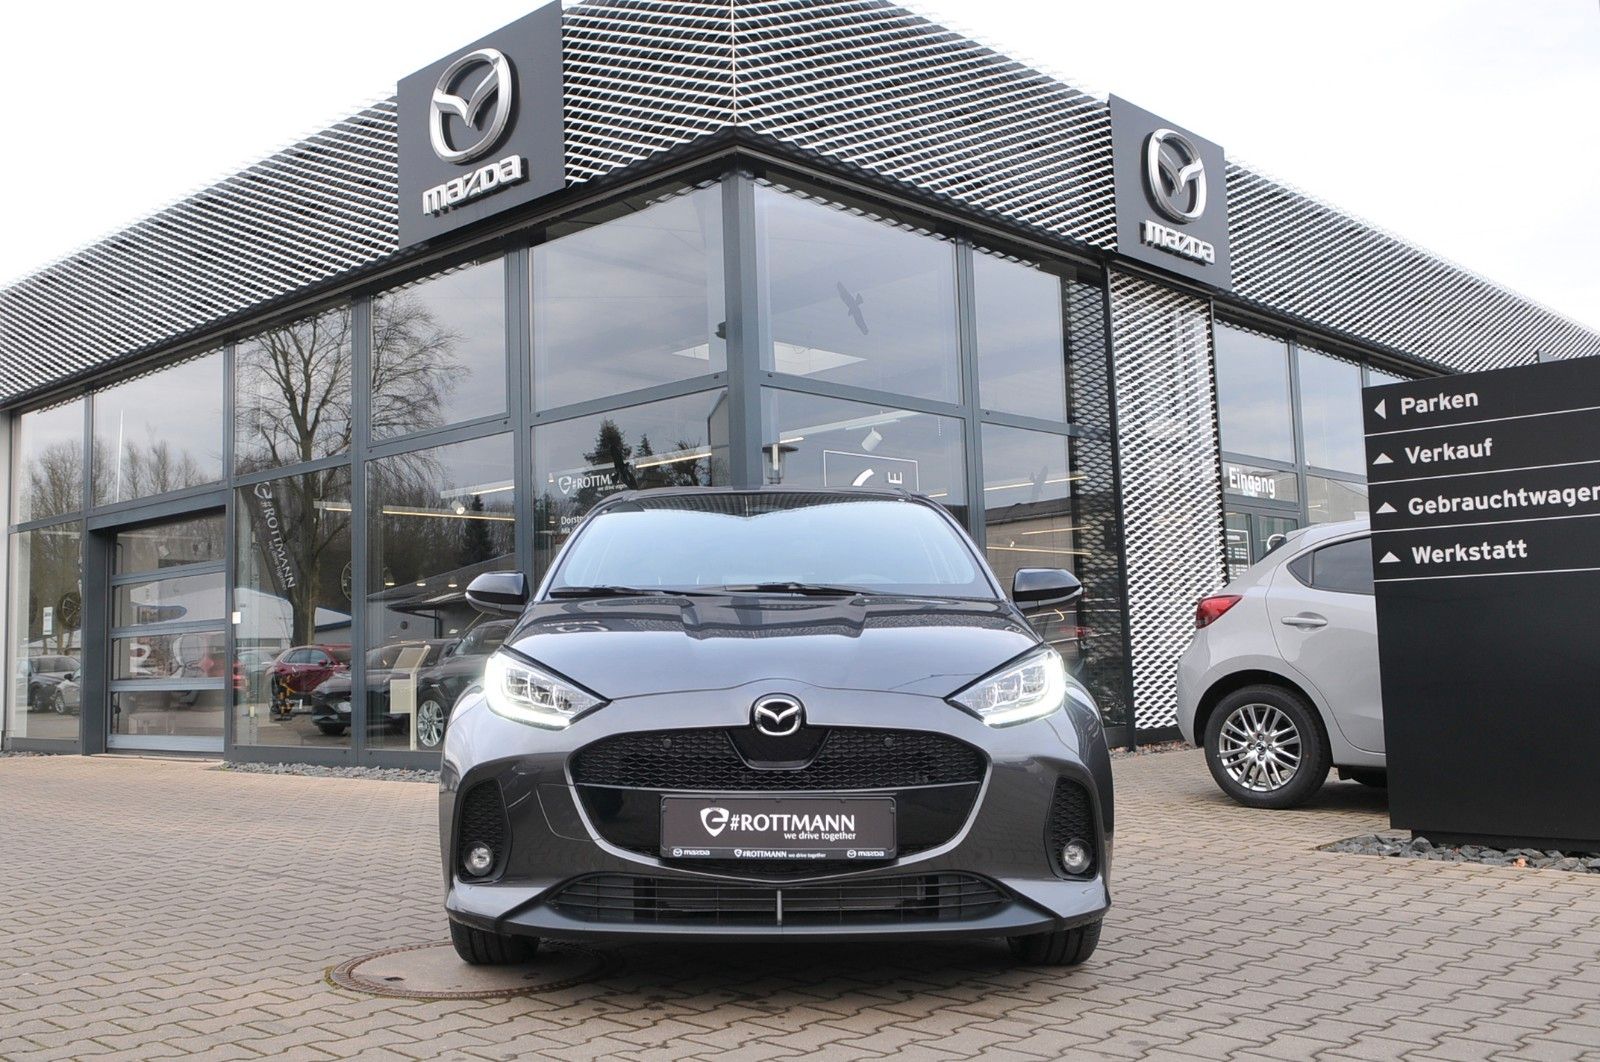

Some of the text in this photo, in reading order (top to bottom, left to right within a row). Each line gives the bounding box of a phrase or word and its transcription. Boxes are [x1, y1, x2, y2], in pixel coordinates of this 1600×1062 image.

[1401, 392, 1479, 416] Parken
[1405, 437, 1493, 464] Verkauf
[1228, 466, 1276, 499] Eingang
[1412, 539, 1528, 565] Werkstatt
[729, 814, 855, 832] #ROTTMANN
[798, 831, 820, 840] drive
[821, 832, 857, 842] together
[742, 850, 787, 858] #ROTTMANN
